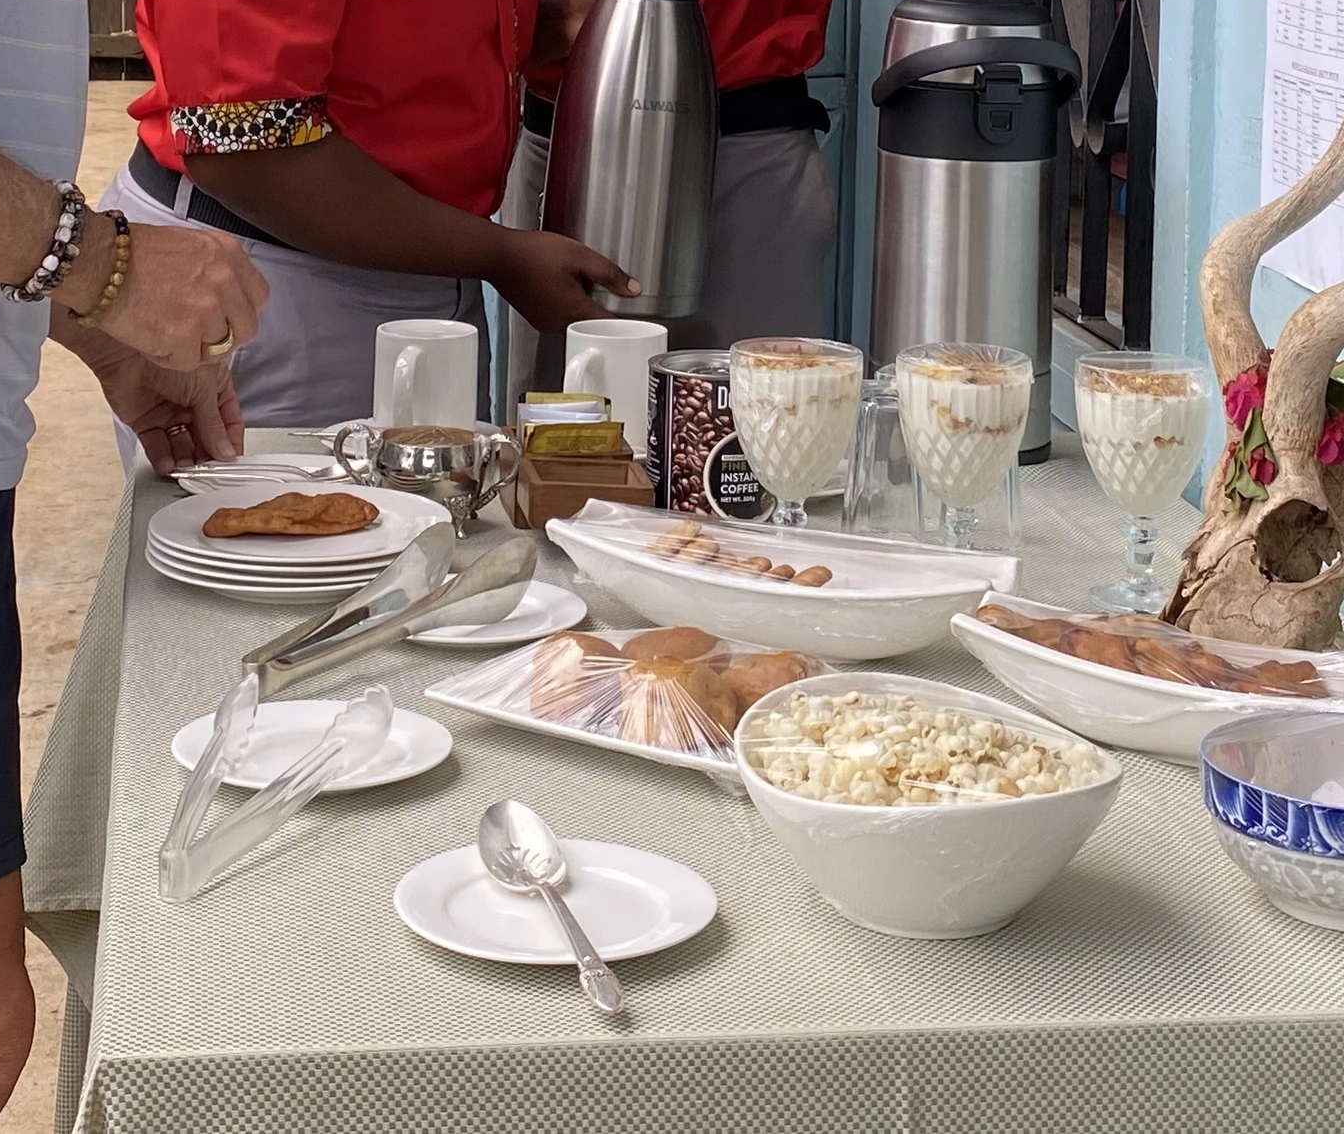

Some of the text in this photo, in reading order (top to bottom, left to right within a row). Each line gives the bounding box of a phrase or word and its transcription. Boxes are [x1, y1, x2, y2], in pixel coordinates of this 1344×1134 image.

[717, 385, 732, 409] D
[721, 461, 747, 471] FINE
[720, 472, 758, 483] INSTAN
[720, 482, 759, 494] COFFEE
